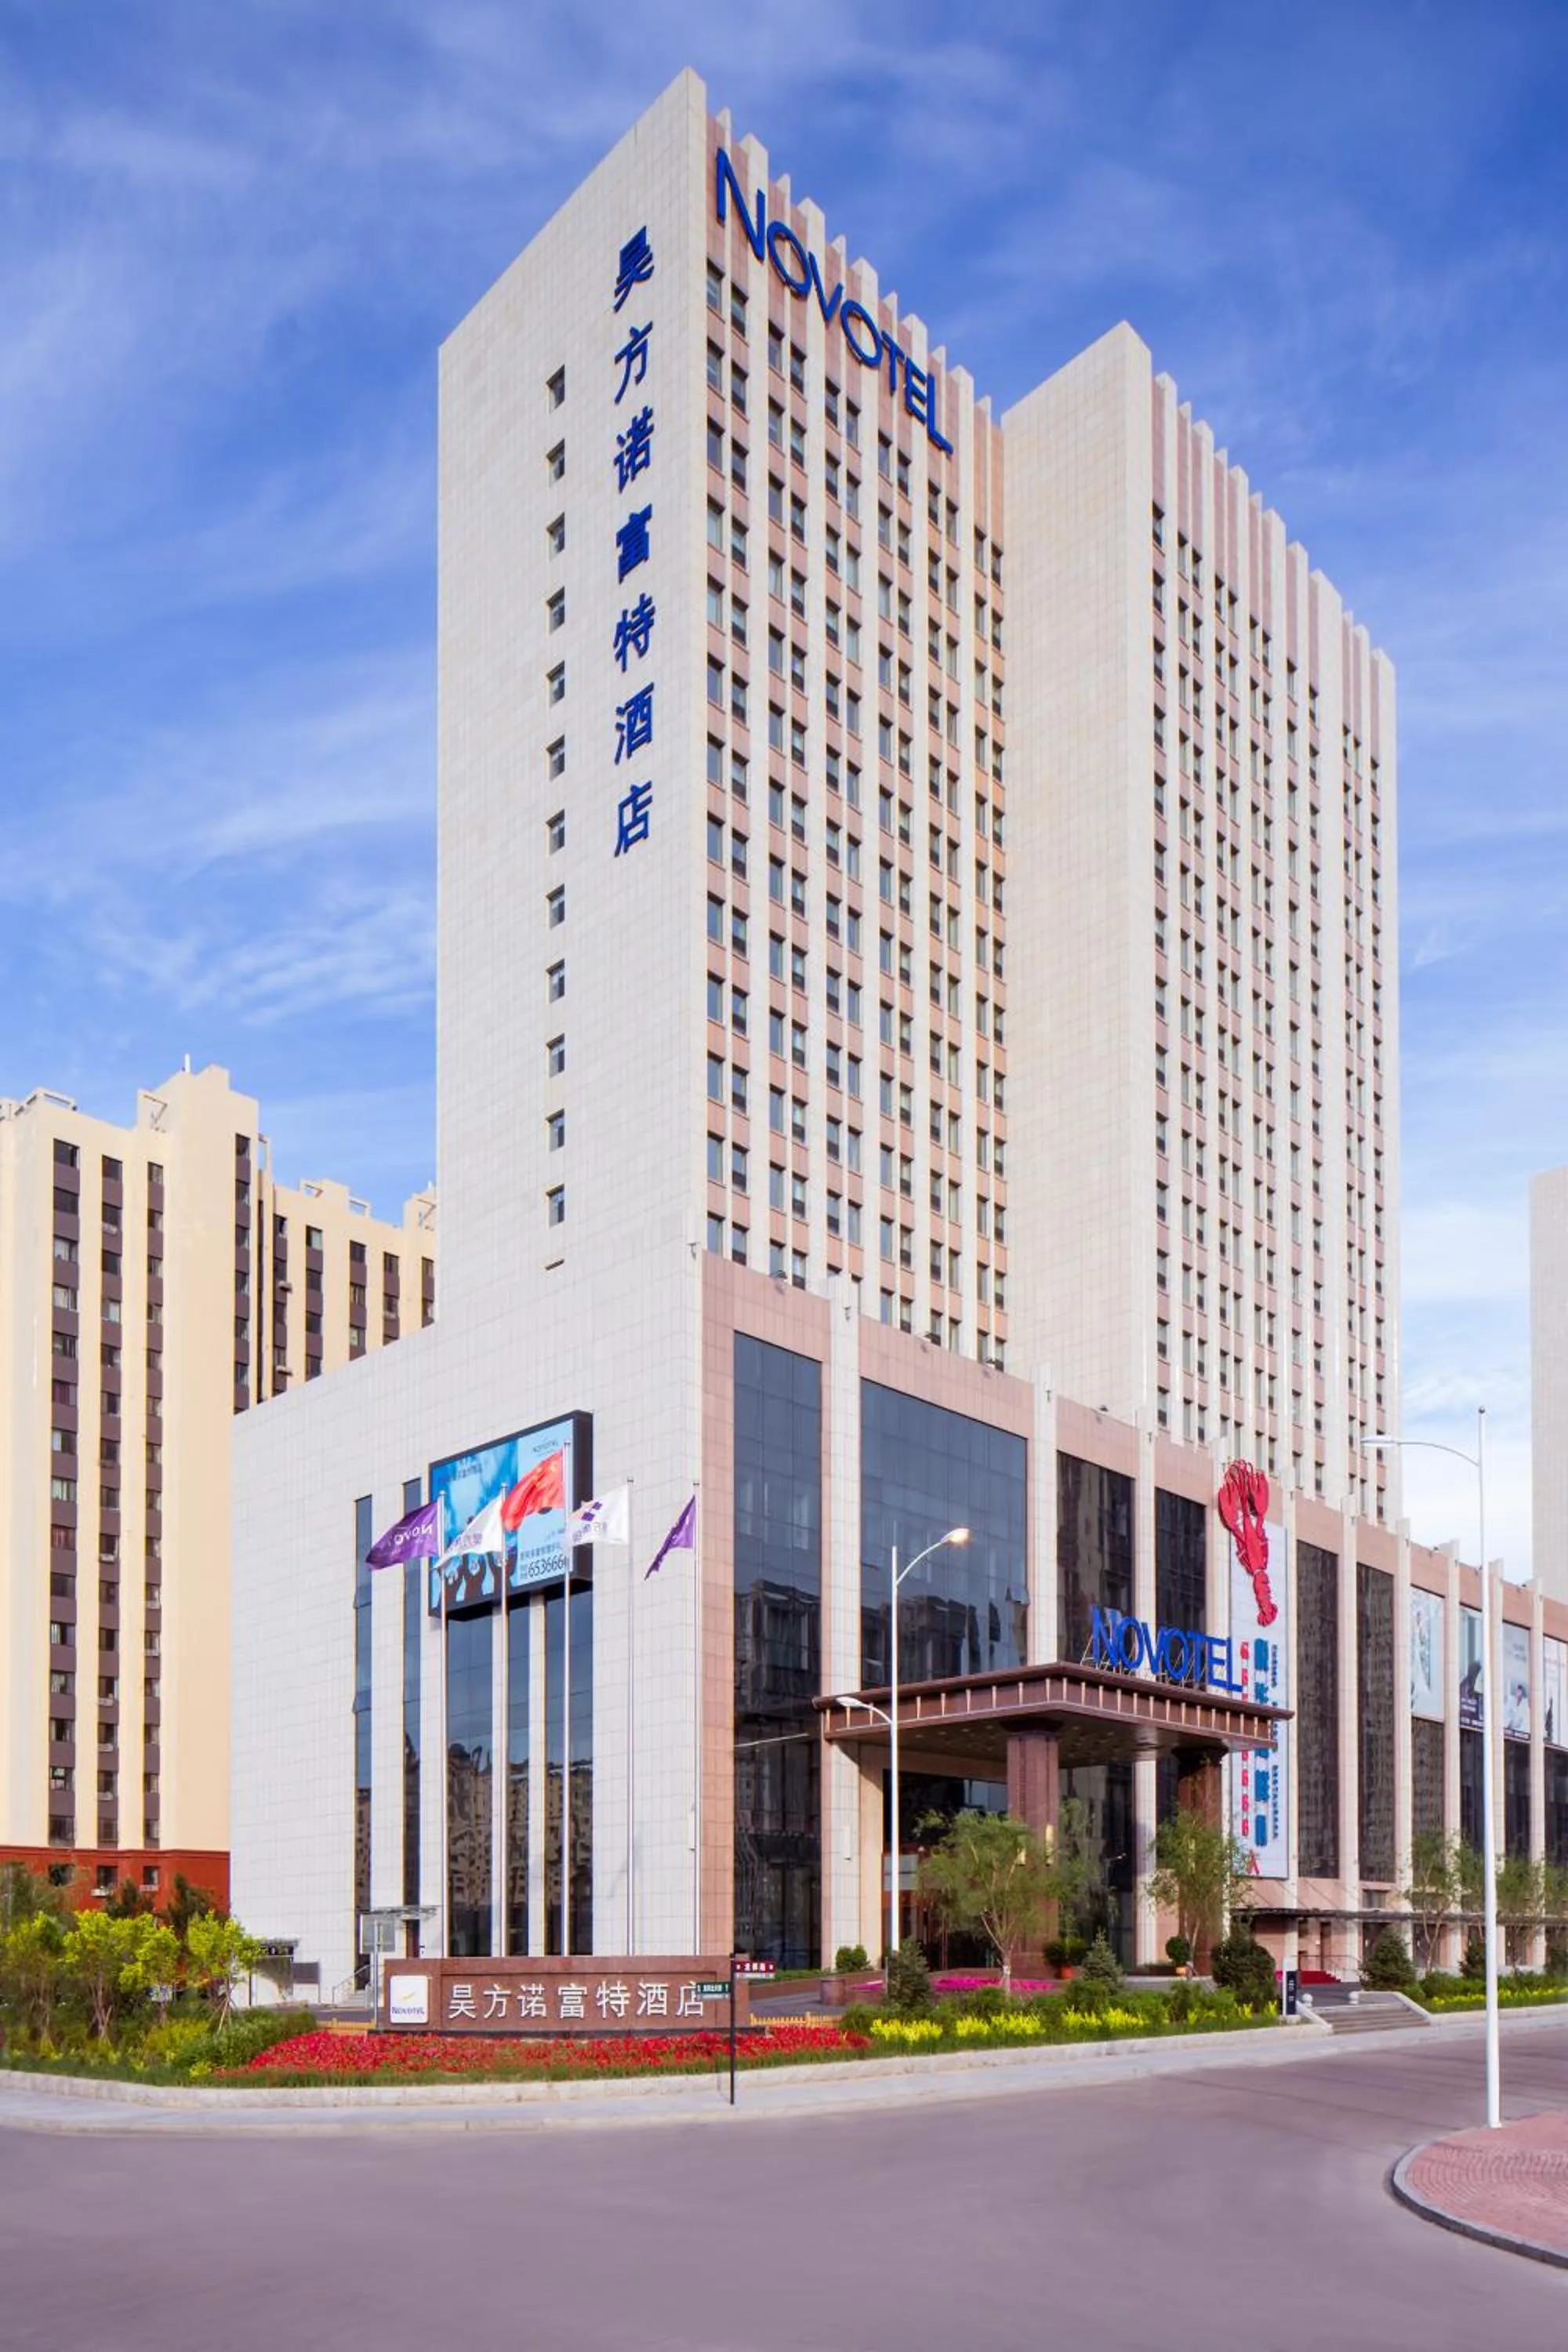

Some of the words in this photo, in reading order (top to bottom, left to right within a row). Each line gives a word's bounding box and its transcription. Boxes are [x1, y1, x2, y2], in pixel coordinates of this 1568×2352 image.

[717, 147, 953, 456] NOVOTEL
[614, 226, 655, 858] 昊方诺富特酒店
[1091, 1605, 1243, 1693] NOVOTEL
[448, 1981, 704, 2020] 昊方诺富特酒店
